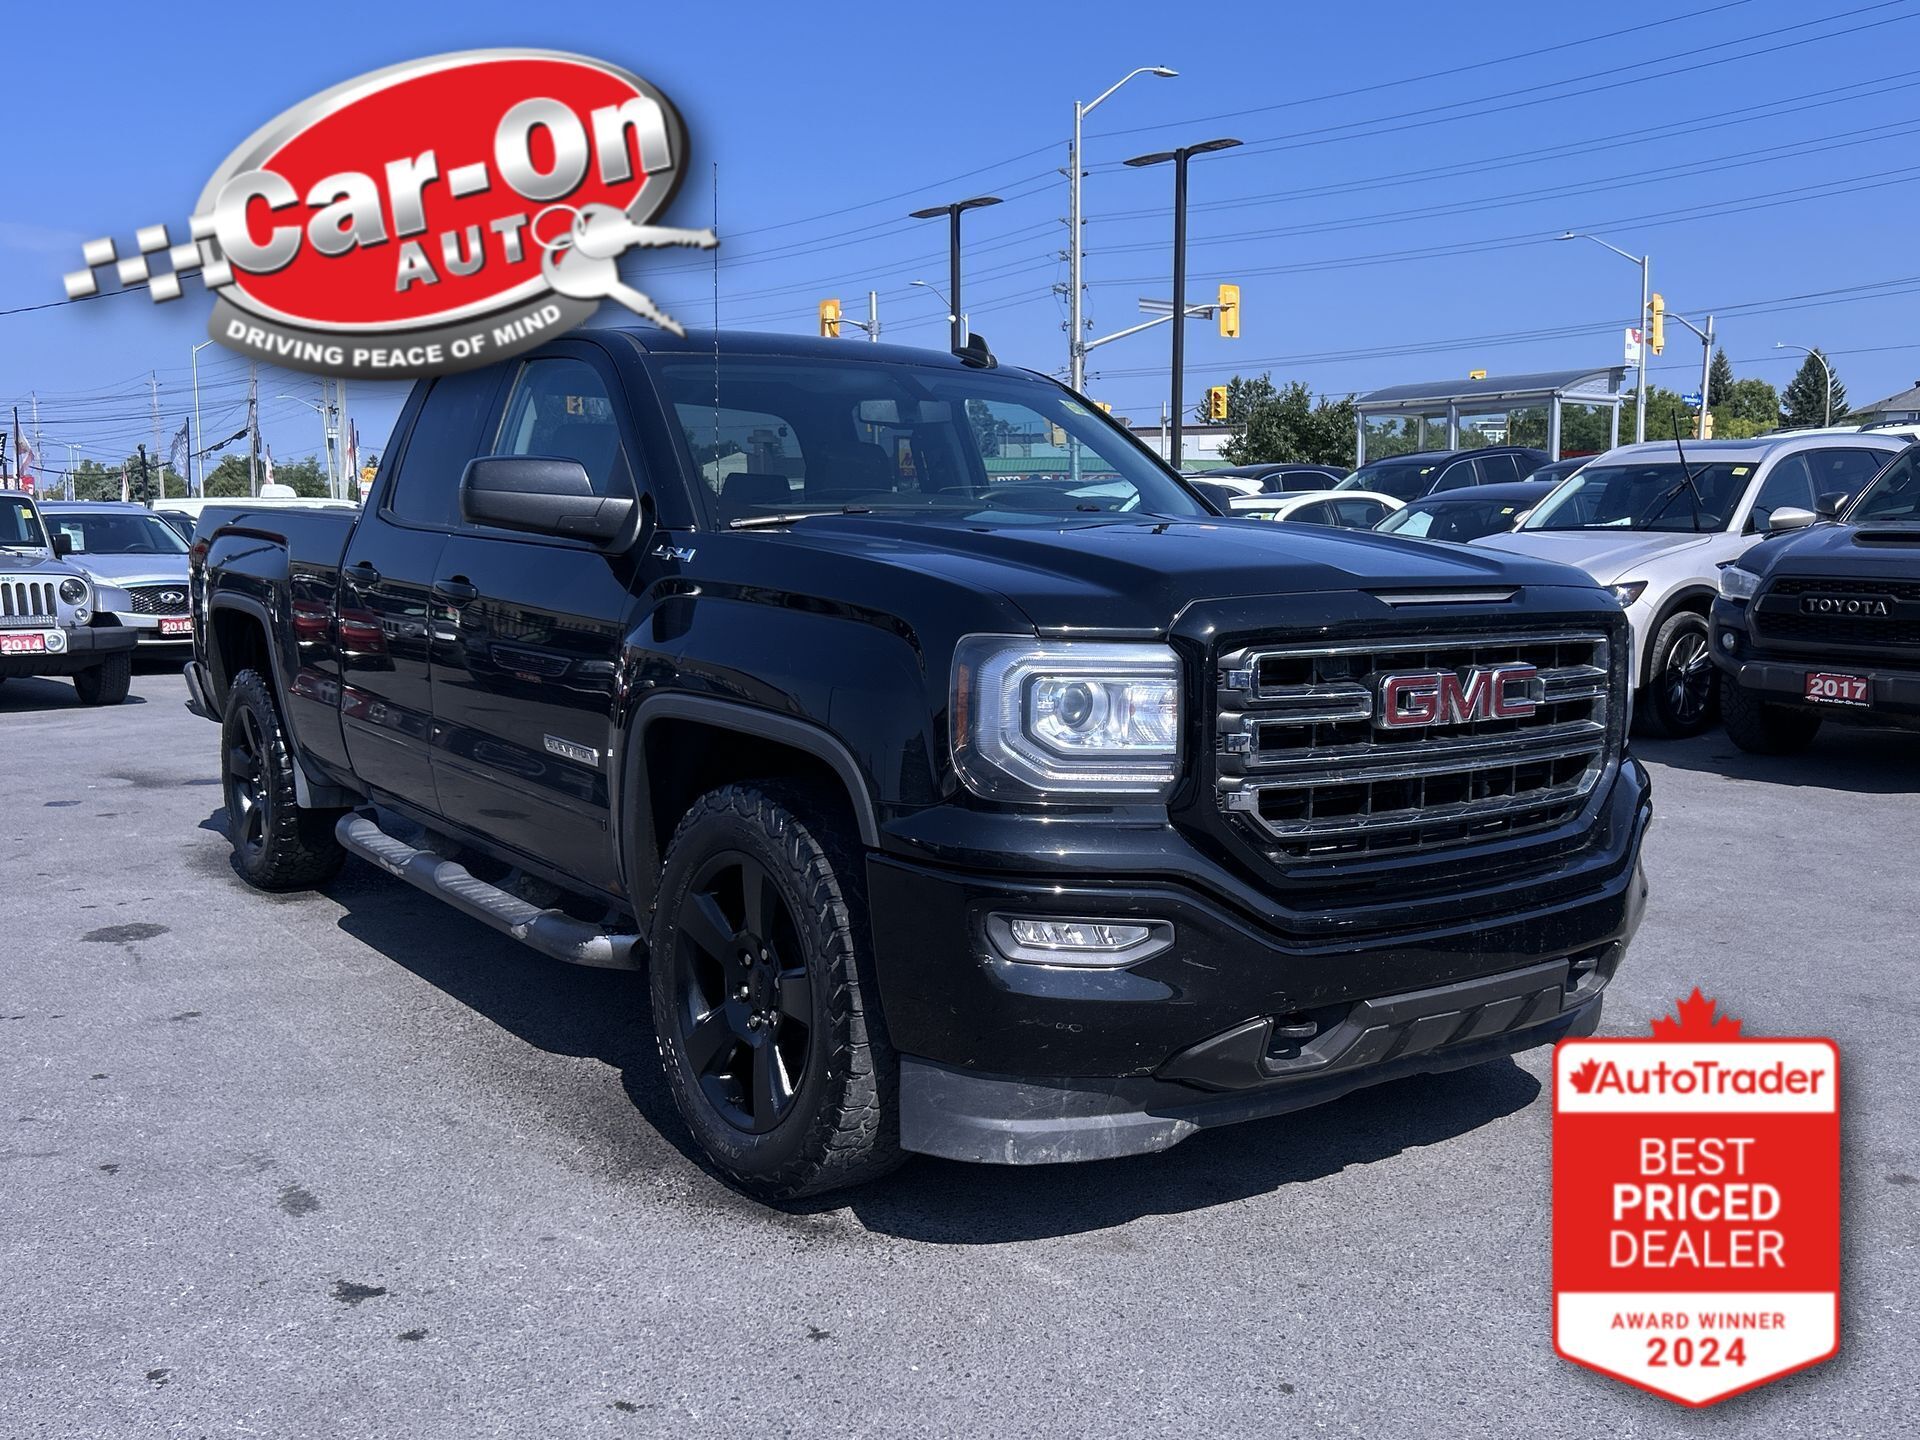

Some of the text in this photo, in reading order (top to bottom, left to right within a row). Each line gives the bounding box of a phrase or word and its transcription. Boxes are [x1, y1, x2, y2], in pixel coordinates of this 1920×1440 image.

[1807, 598, 1887, 615] TOYOTA
[162, 621, 191, 632] 2018
[1, 639, 43, 650] 2014
[1380, 664, 1538, 729] GMC
[1810, 678, 1867, 699] 2017
[547, 739, 594, 761] ELEVATION
